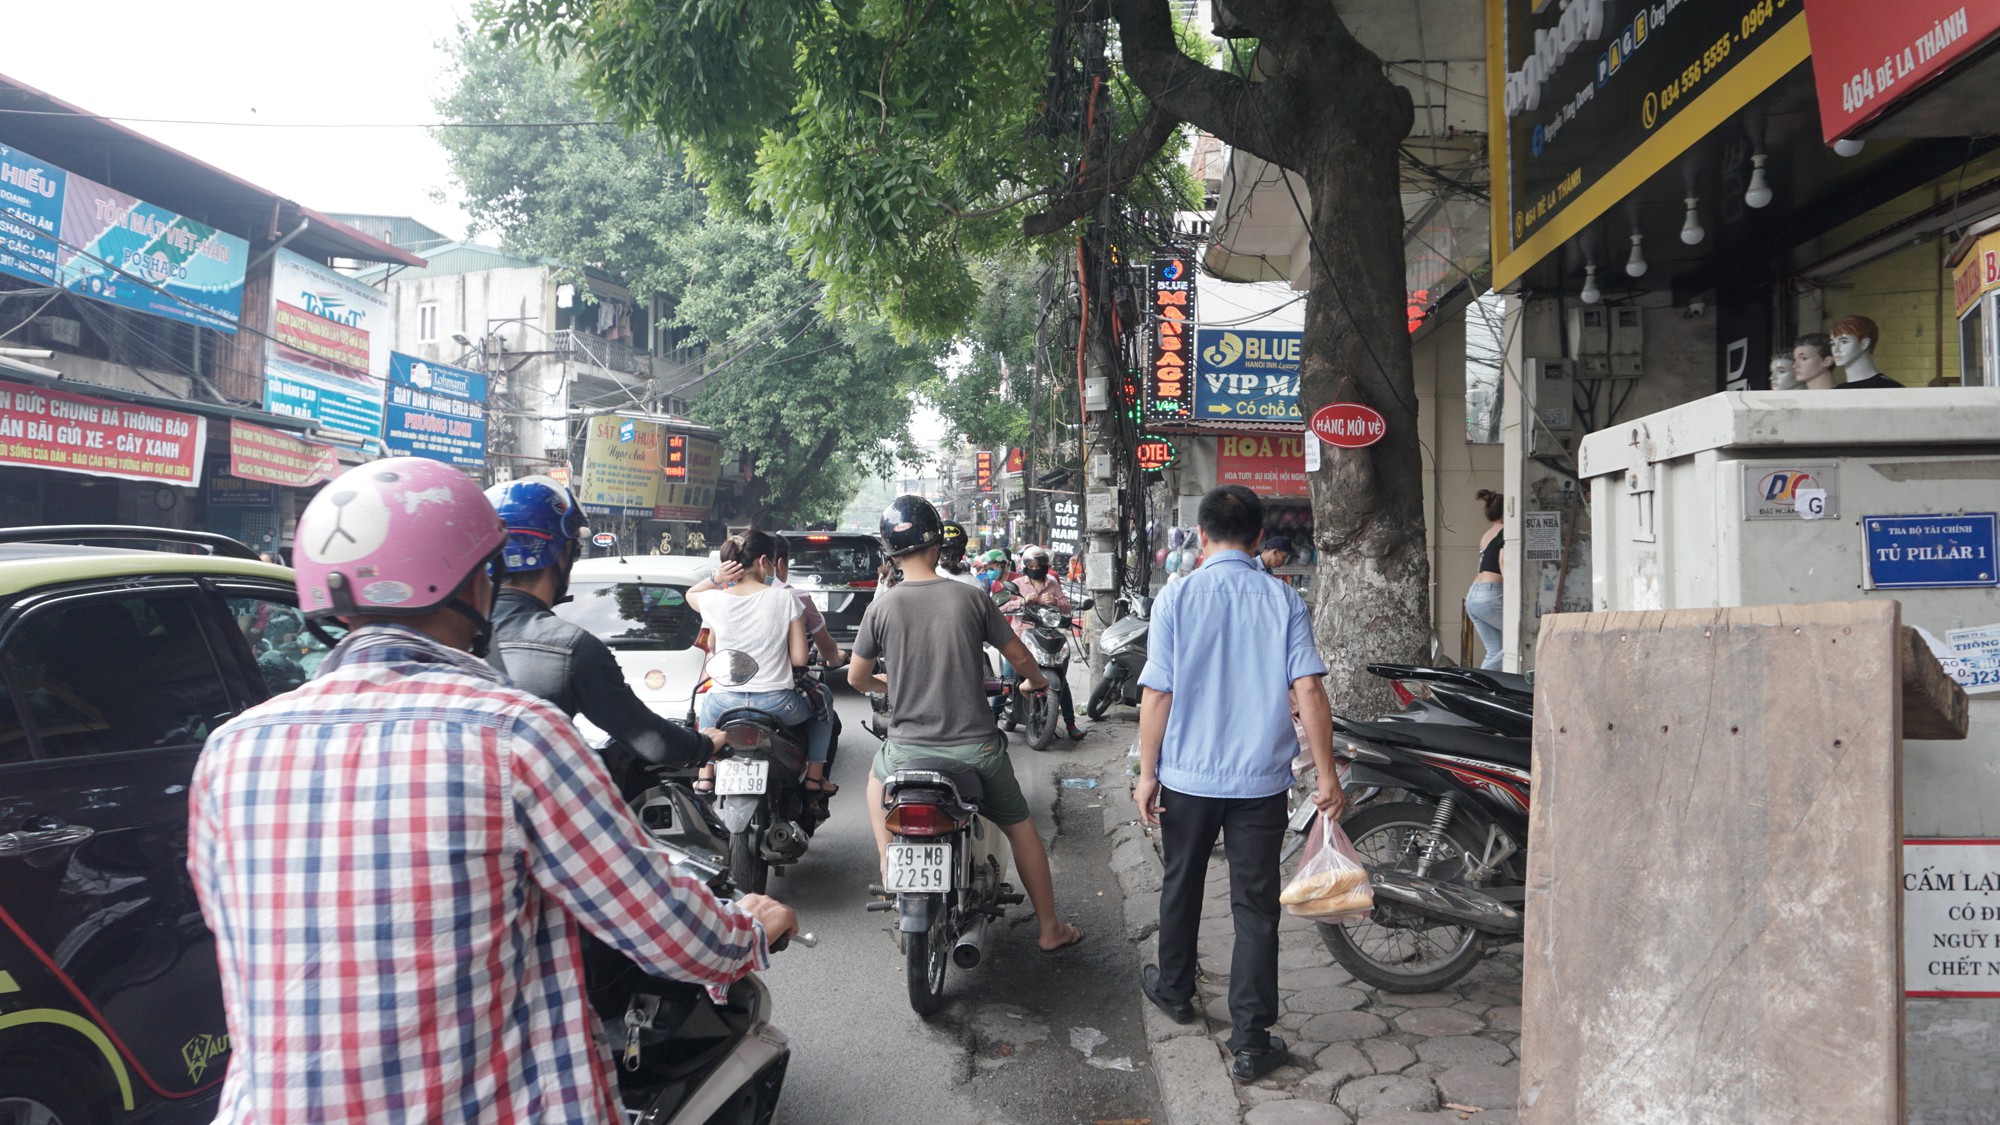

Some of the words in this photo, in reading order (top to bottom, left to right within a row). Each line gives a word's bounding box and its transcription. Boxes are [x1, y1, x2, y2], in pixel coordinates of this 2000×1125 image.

[1661, 79, 1680, 110] 034
[1681, 60, 1701, 93] 556
[1703, 32, 1730, 74] 5555
[1741, 0, 1773, 39] 0964
[1843, 67, 1874, 113] 464
[1896, 47, 1915, 79] LA
[1915, 6, 1968, 64] THÀNH
[1, 163, 56, 198] HIẾU
[95, 198, 127, 229] TÔN
[129, 212, 165, 240] MÁT
[123, 248, 187, 280] POSHACO
[1157, 281, 1188, 290] BLUE
[1245, 337, 1300, 360] BLUE
[1205, 373, 1258, 395] VIP
[15, 390, 46, 415] ĐỨC
[50, 400, 98, 423] CHUNG
[101, 407, 119, 427] ĐÃ
[123, 411, 163, 433] THÔNG
[165, 417, 189, 438] BÁO
[1236, 401, 1256, 415] Có
[1259, 400, 1286, 416] chỗ
[1289, 404, 1302, 416] đ
[1317, 416, 1345, 437] HÀNG
[1347, 416, 1366, 436] MỚI
[1368, 418, 1381, 435] VỀ
[27, 420, 53, 442] BÃI
[57, 421, 82, 446] GỬI
[85, 430, 104, 449] XE
[116, 433, 143, 454] CÂY
[145, 439, 179, 458] XANH
[1223, 436, 1273, 457] HOA
[10, 442, 32, 459] SỐNG
[33, 443, 49, 461] CỦA
[1137, 444, 1171, 461] OTEL
[1224, 472, 1236, 480] HOA
[1254, 472, 1263, 482] SỰ
[1054, 500, 1079, 515] CẮT
[1775, 507, 1796, 515] HOÀN
[1809, 497, 1822, 514] G
[1055, 514, 1077, 527] TÓC
[1051, 528, 1078, 540] NAM
[1909, 527, 1922, 536] BỘ
[1924, 525, 1940, 534] TÀI
[1942, 525, 1972, 534] CHÍNH
[1051, 541, 1074, 554] 50k
[1877, 543, 1900, 561] TỦ
[1907, 545, 1973, 561] PILLAR
[1978, 547, 1986, 559] 1
[1954, 639, 1999, 651] THÔNG
[725, 763, 760, 777] 29-C1
[719, 777, 763, 792] 321.98
[895, 847, 943, 867] 29-M8
[895, 869, 942, 888] 2259
[1903, 865, 1955, 891] CẤM
[1949, 902, 1975, 921] CÓ
[1928, 955, 1982, 976] CHẾT
[208, 1033, 231, 1058] AU
